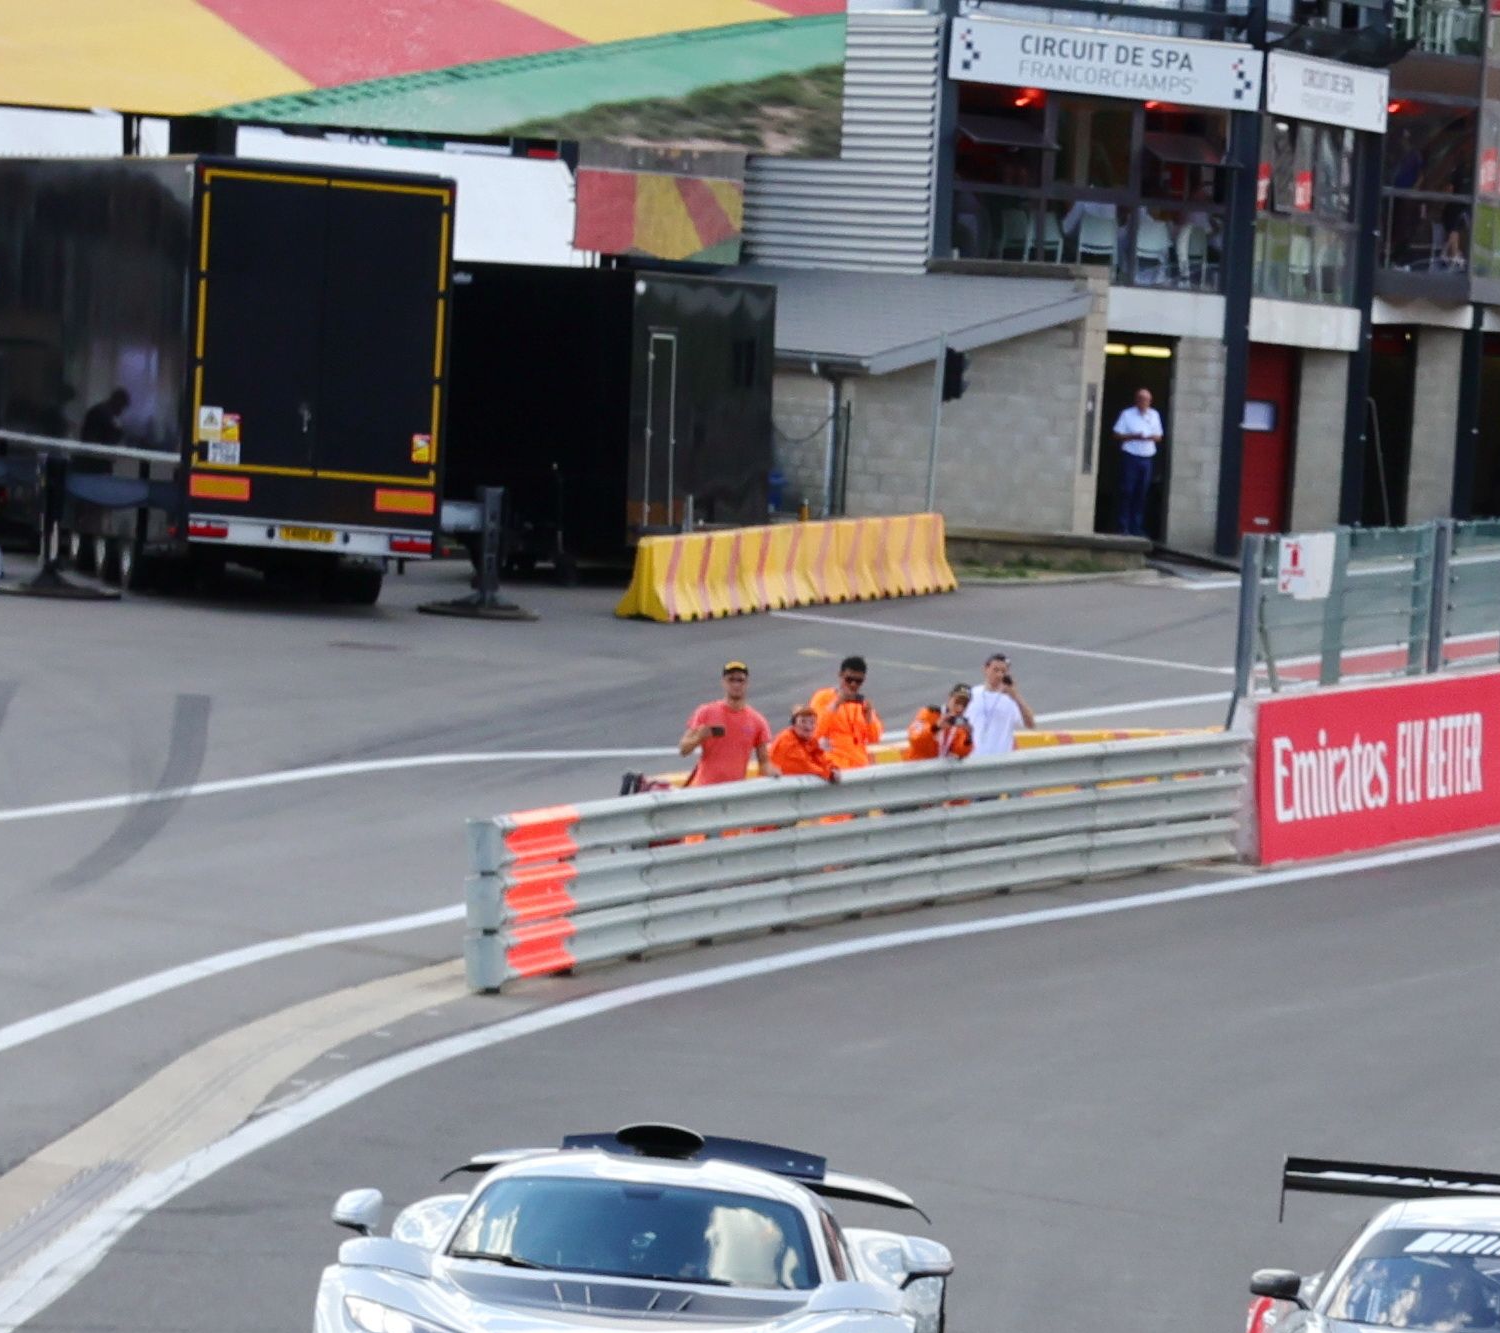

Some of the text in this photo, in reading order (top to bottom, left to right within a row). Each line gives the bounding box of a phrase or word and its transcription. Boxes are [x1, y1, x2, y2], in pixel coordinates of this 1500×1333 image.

[1021, 34, 1194, 73] CIRCUIT DE SPA
[1018, 60, 1194, 96] FRANCORCHAMPS
[1271, 711, 1484, 824] Emirates FLY BETTER
